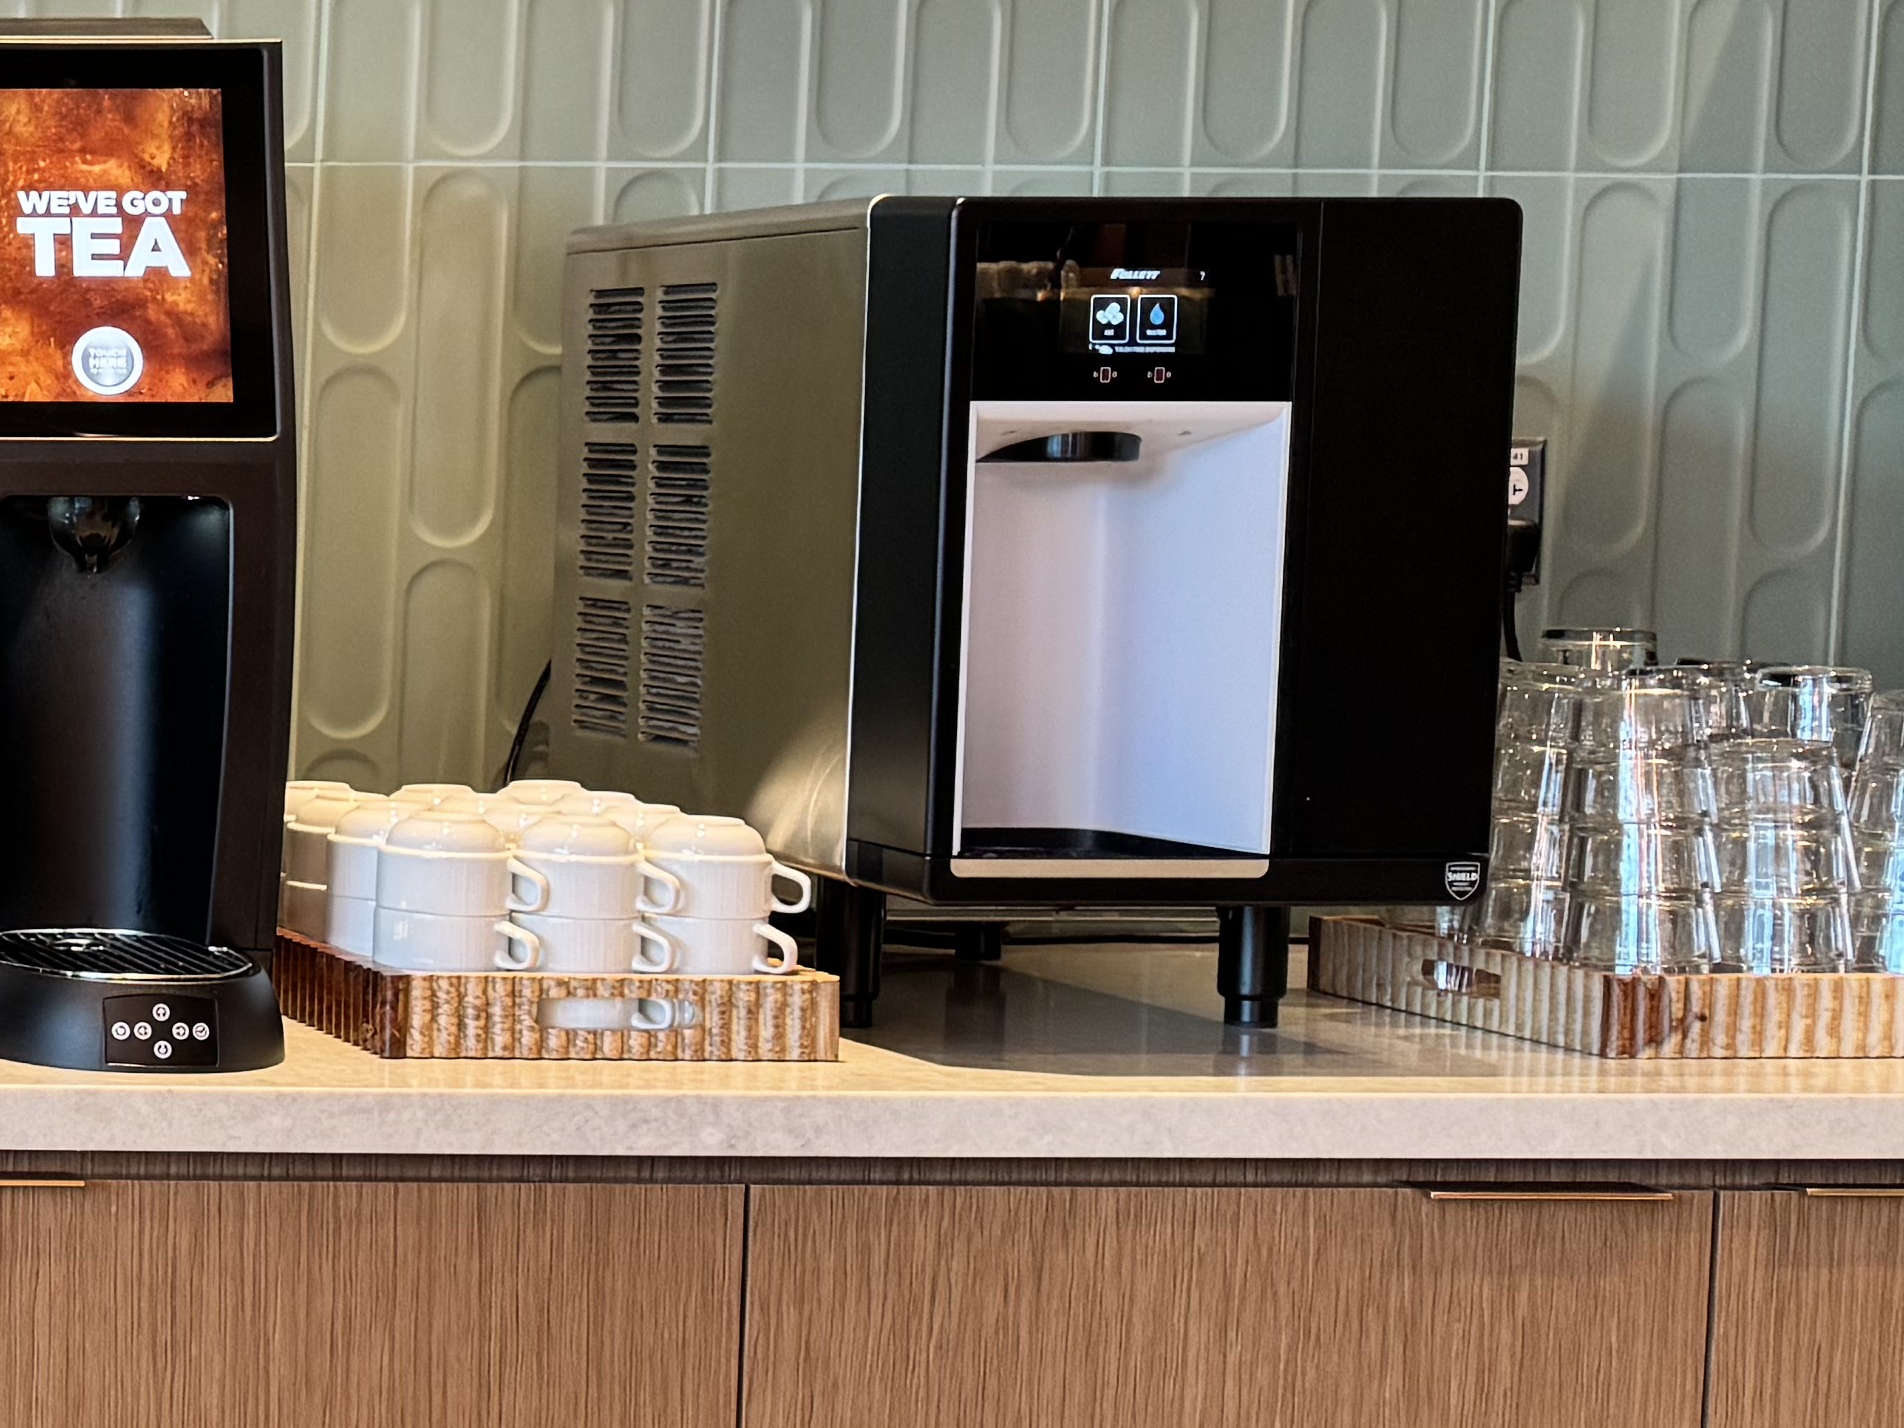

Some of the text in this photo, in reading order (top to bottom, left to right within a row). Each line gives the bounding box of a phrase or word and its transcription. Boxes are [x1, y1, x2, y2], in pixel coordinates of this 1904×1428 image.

[16, 190, 187, 215] WE'VE GOT
[16, 216, 192, 277] TEA
